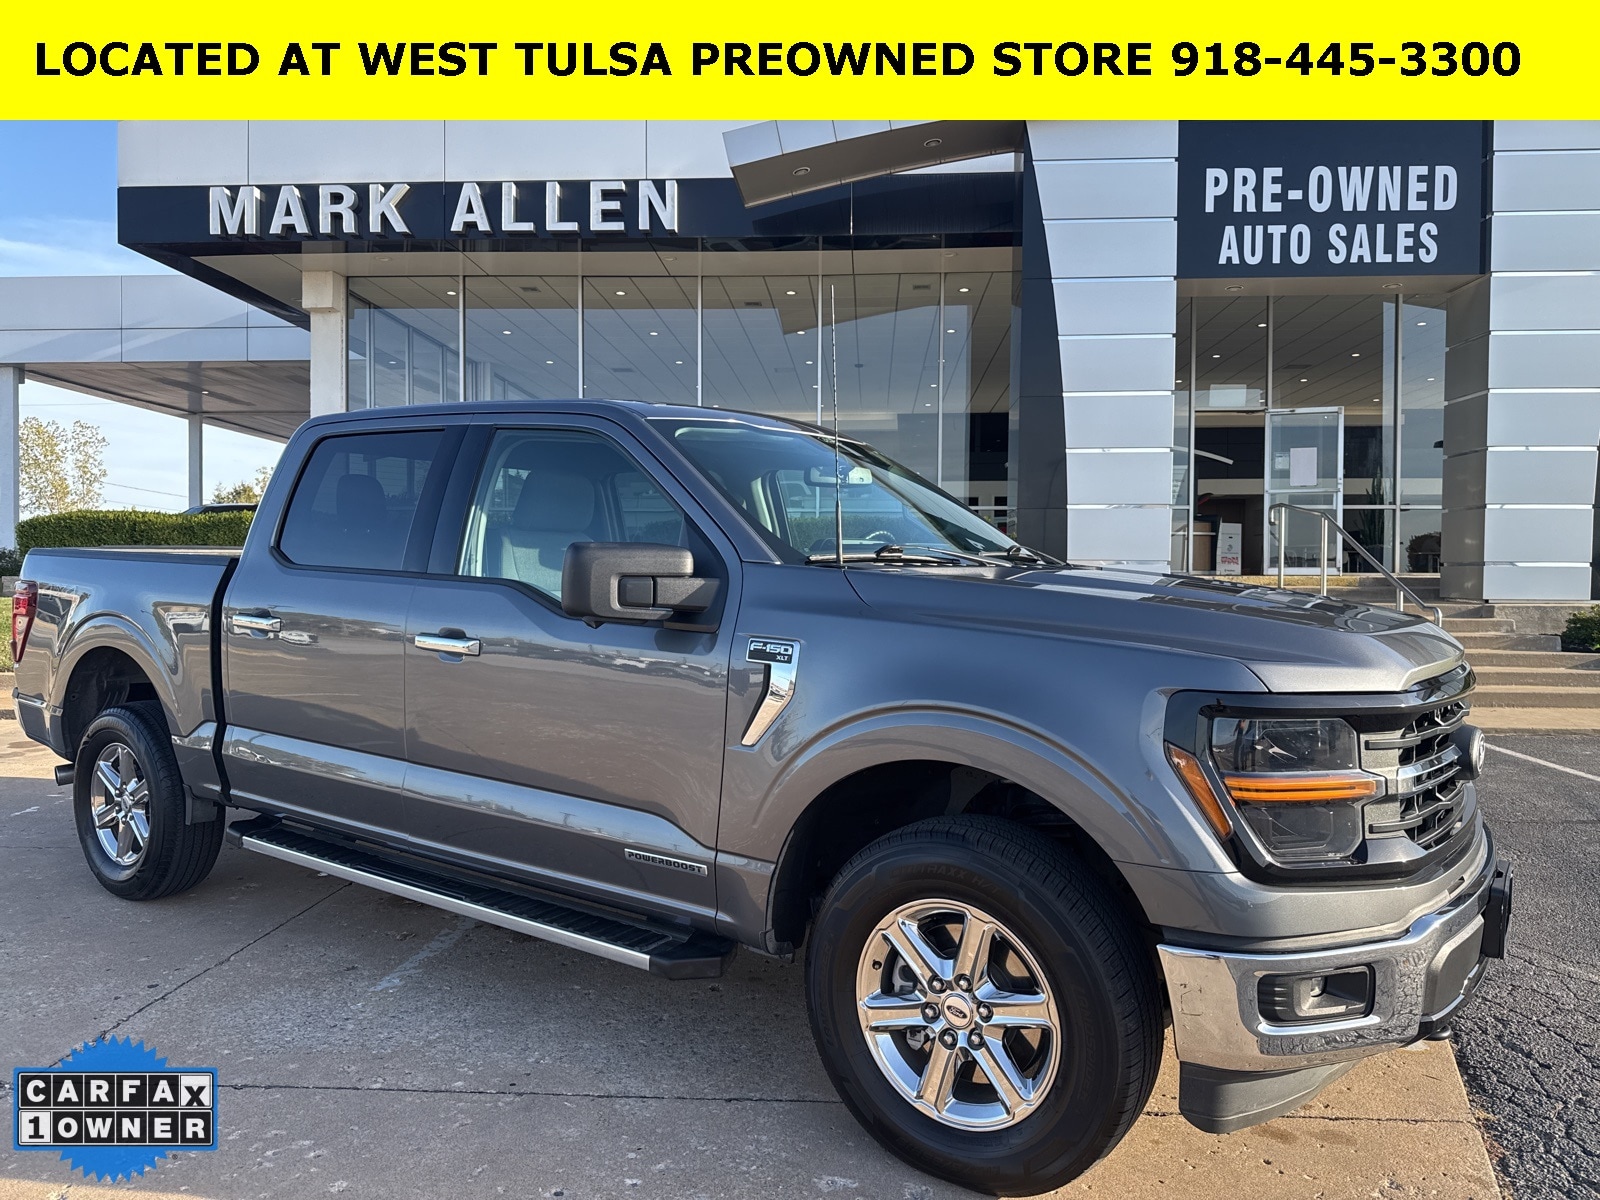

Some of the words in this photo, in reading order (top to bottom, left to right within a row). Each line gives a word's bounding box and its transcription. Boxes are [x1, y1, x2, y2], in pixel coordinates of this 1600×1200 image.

[1204, 165, 1459, 213] PRE-OWNED
[209, 183, 412, 236] MARK
[449, 180, 679, 235] ALLEN
[1217, 223, 1312, 266] AUTO
[1327, 222, 1439, 264] SALES
[750, 642, 793, 655] F-150
[627, 851, 703, 873] POWERBOOST
[948, 1006, 966, 1018] Ford
